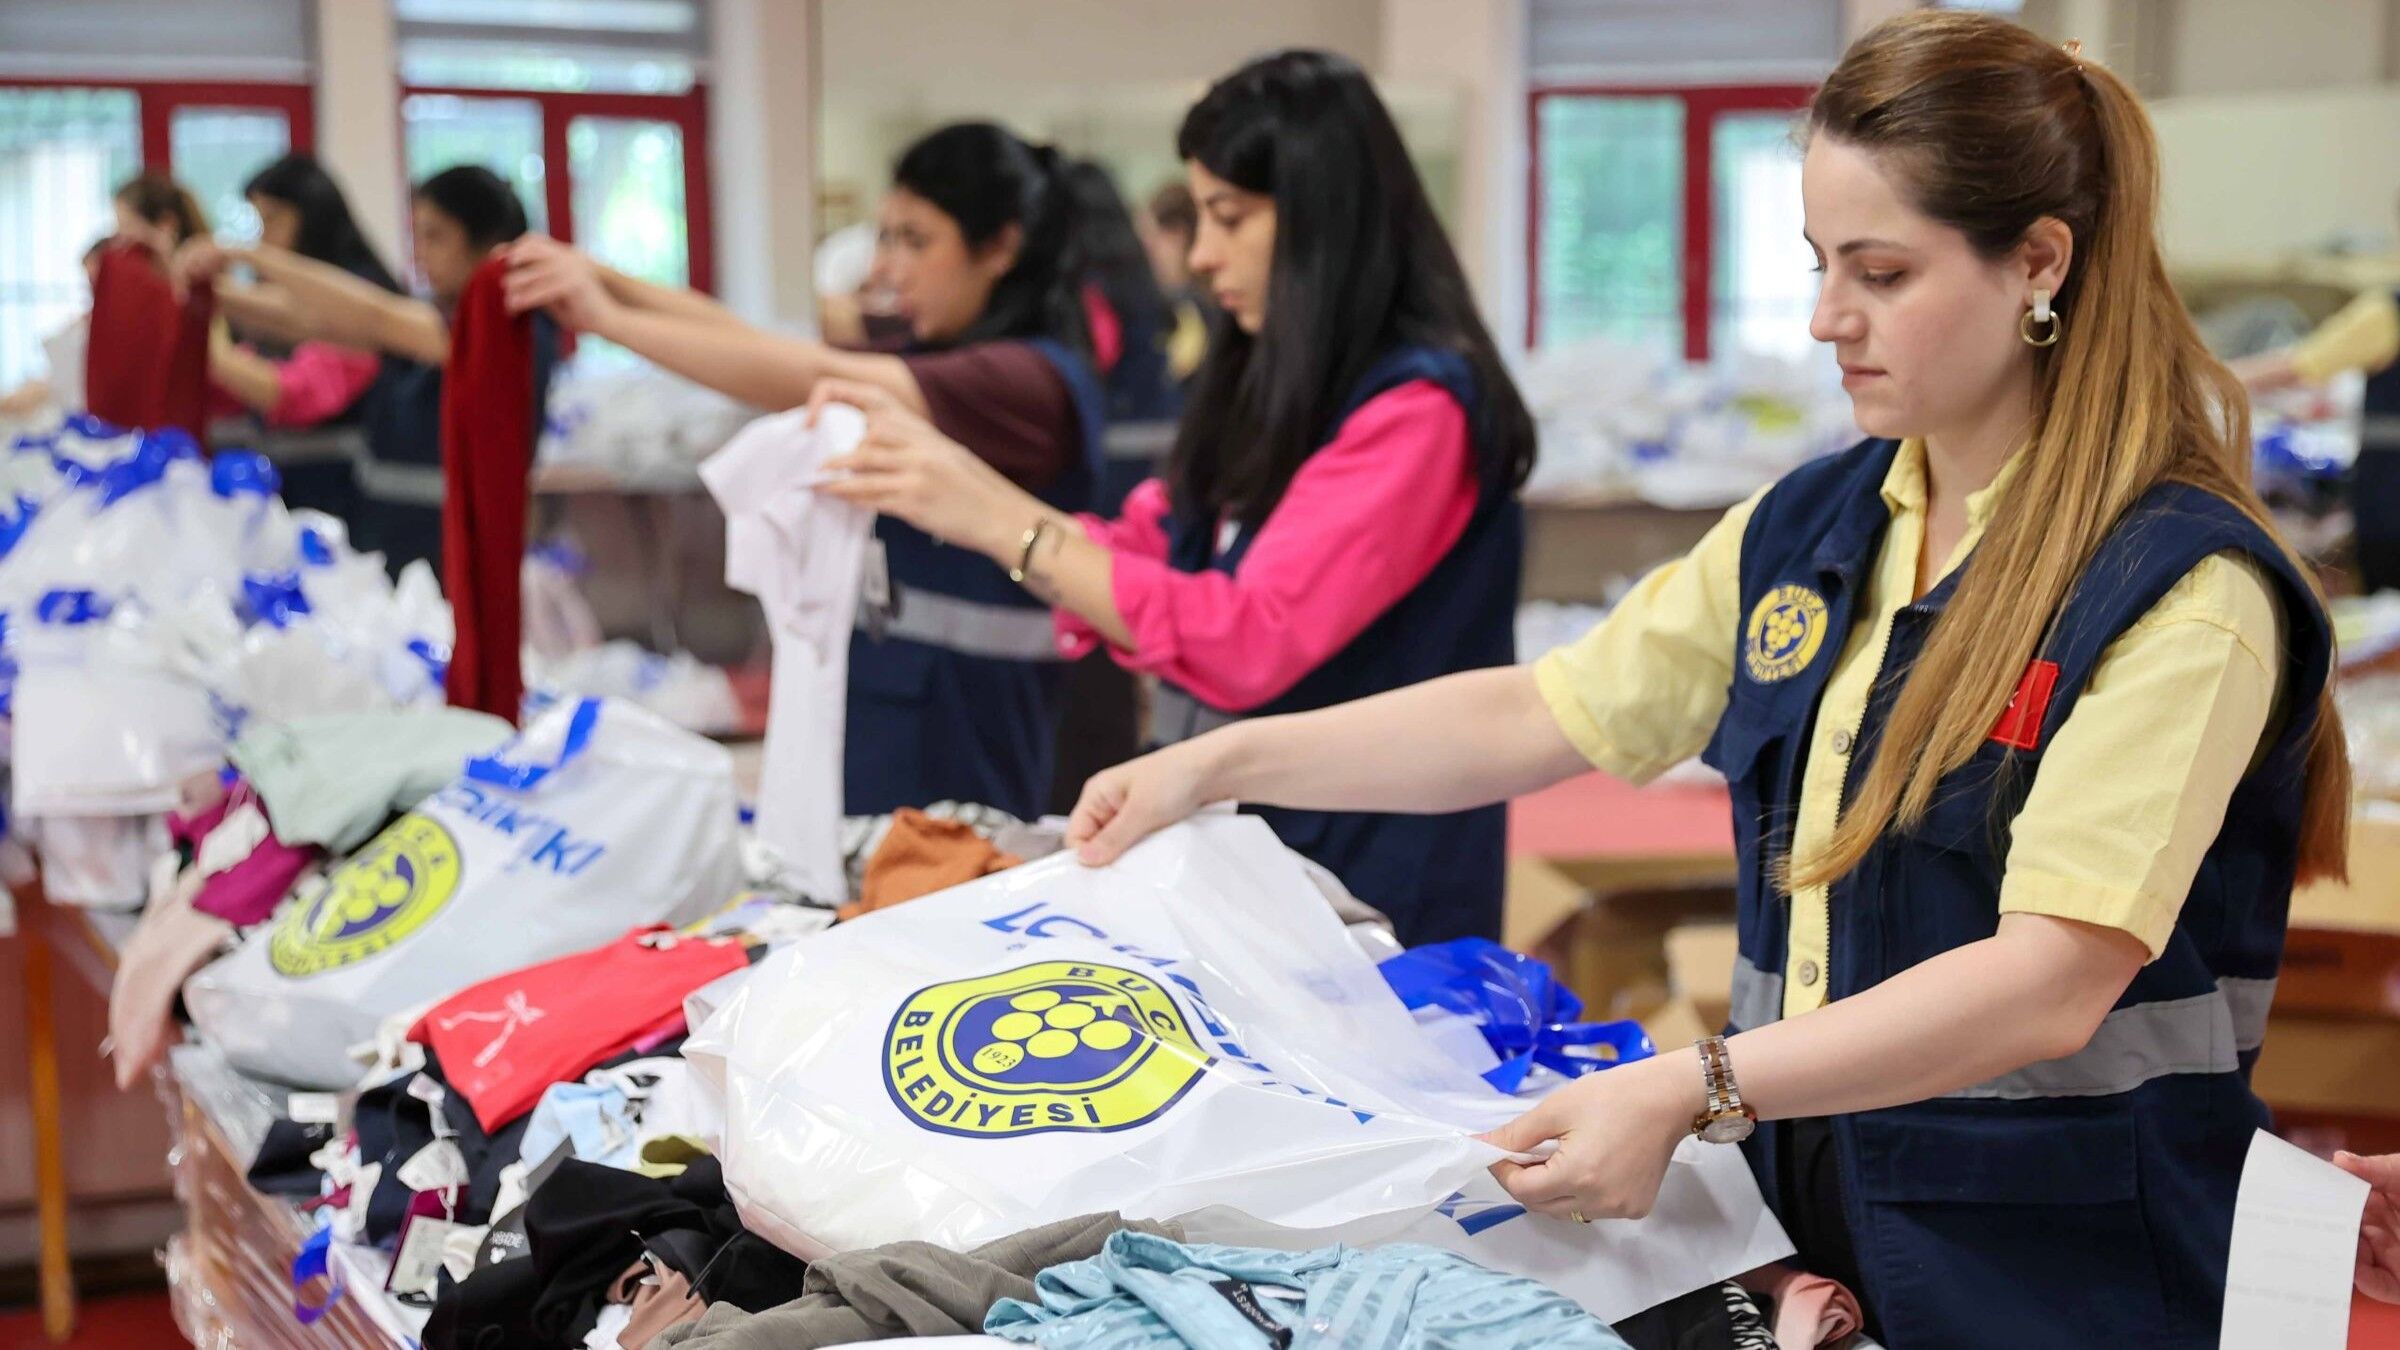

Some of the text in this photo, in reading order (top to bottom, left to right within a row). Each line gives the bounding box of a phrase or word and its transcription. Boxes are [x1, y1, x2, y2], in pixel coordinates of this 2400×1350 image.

[1066, 966, 1177, 1034] BUC
[895, 1010, 1101, 1127] BELEDİYESİ
[981, 1046, 1017, 1069] 1923
